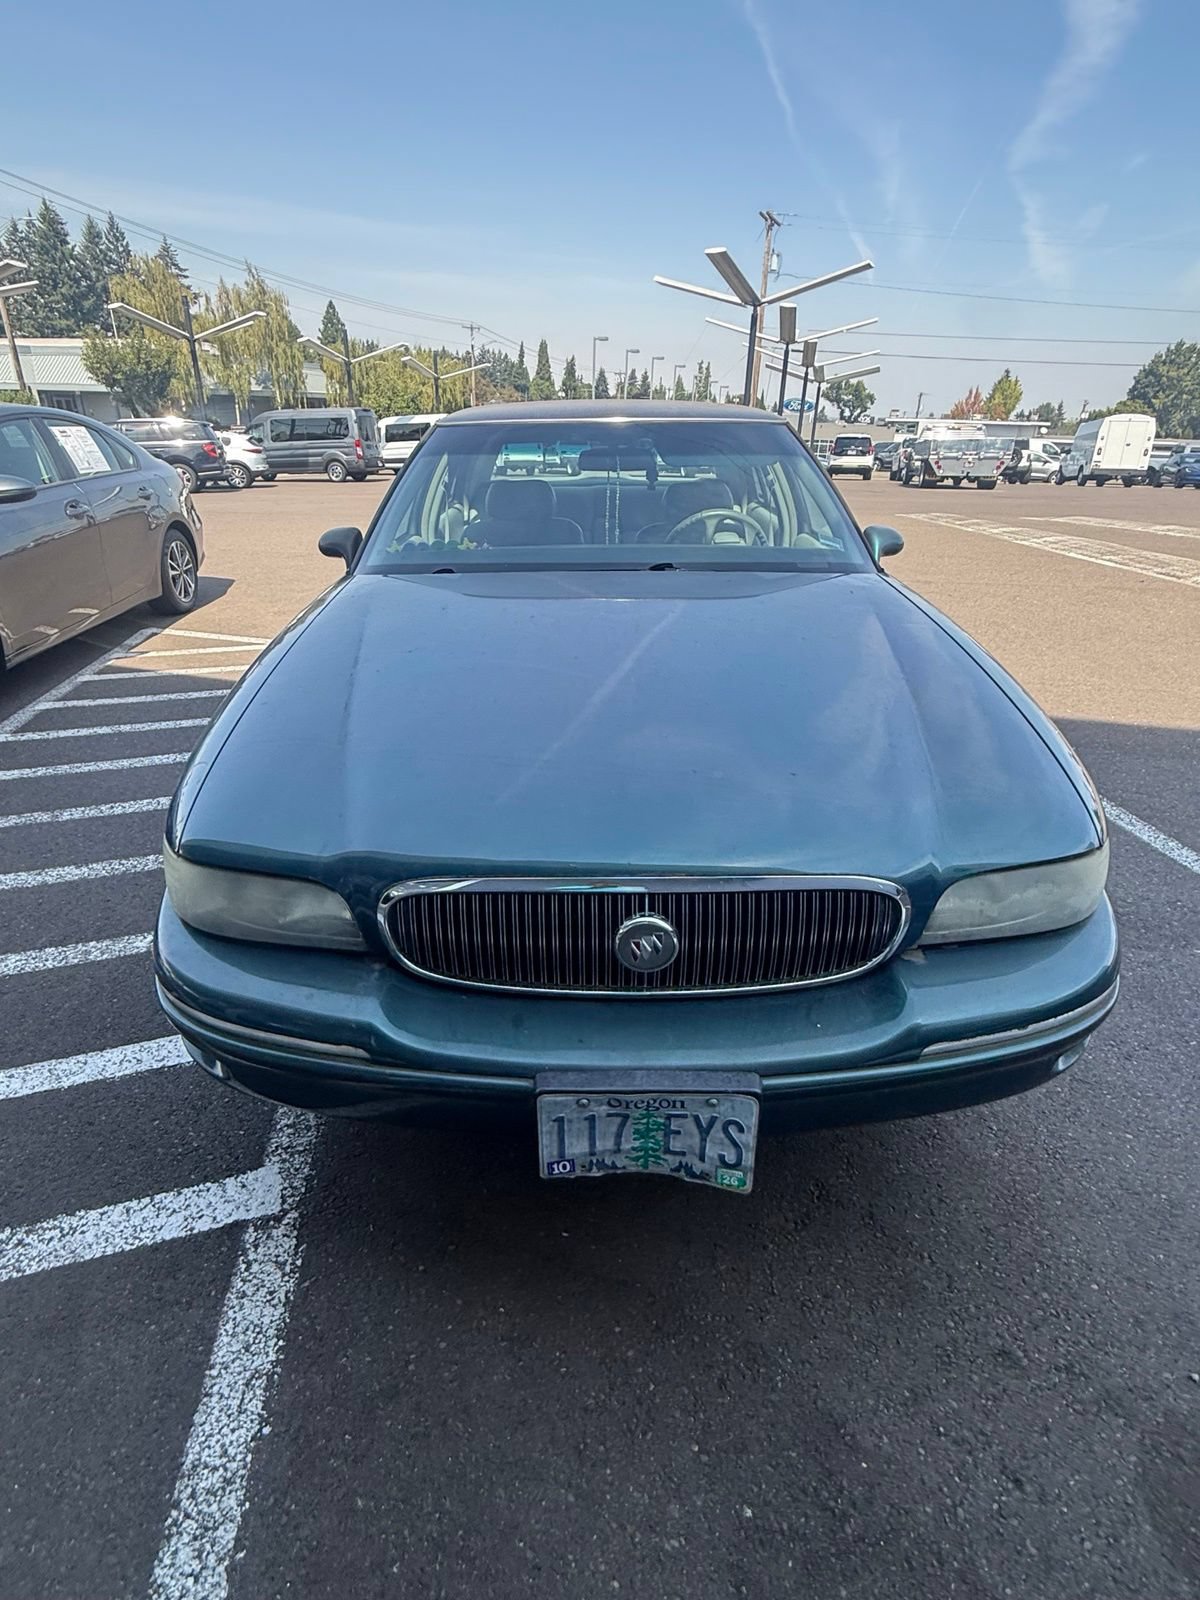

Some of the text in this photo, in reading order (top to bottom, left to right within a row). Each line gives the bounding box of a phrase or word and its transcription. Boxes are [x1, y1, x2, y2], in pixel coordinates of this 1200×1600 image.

[607, 1098, 686, 1111] Oregon
[552, 1112, 746, 1169] 117 EYS
[552, 1161, 570, 1175] 10
